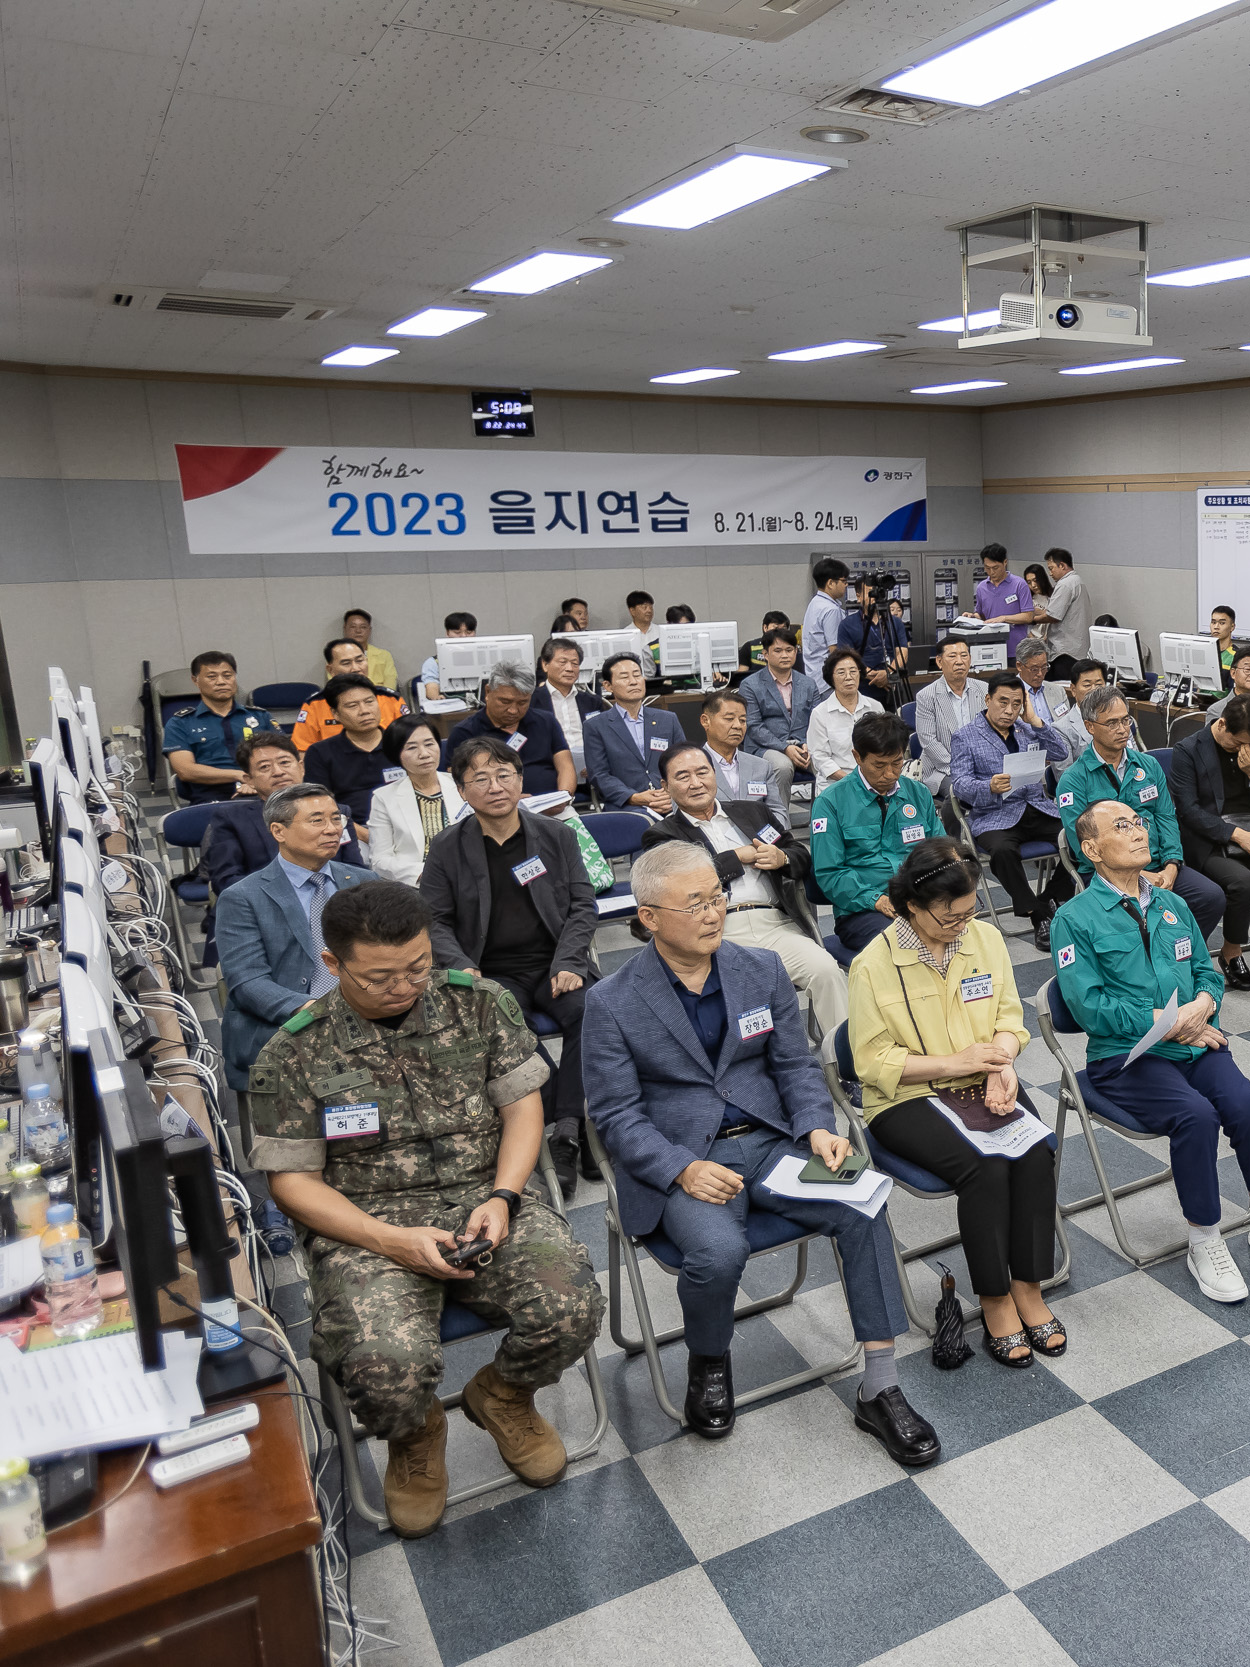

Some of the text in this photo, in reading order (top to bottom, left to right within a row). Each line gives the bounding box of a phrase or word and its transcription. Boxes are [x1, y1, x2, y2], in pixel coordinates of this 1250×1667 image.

[882, 470, 913, 481] 광진구
[328, 490, 690, 536] 2023 을지연습
[714, 512, 730, 532] 8.
[815, 511, 858, 531] 24.(목)
[337, 1118, 369, 1130] 허 준
